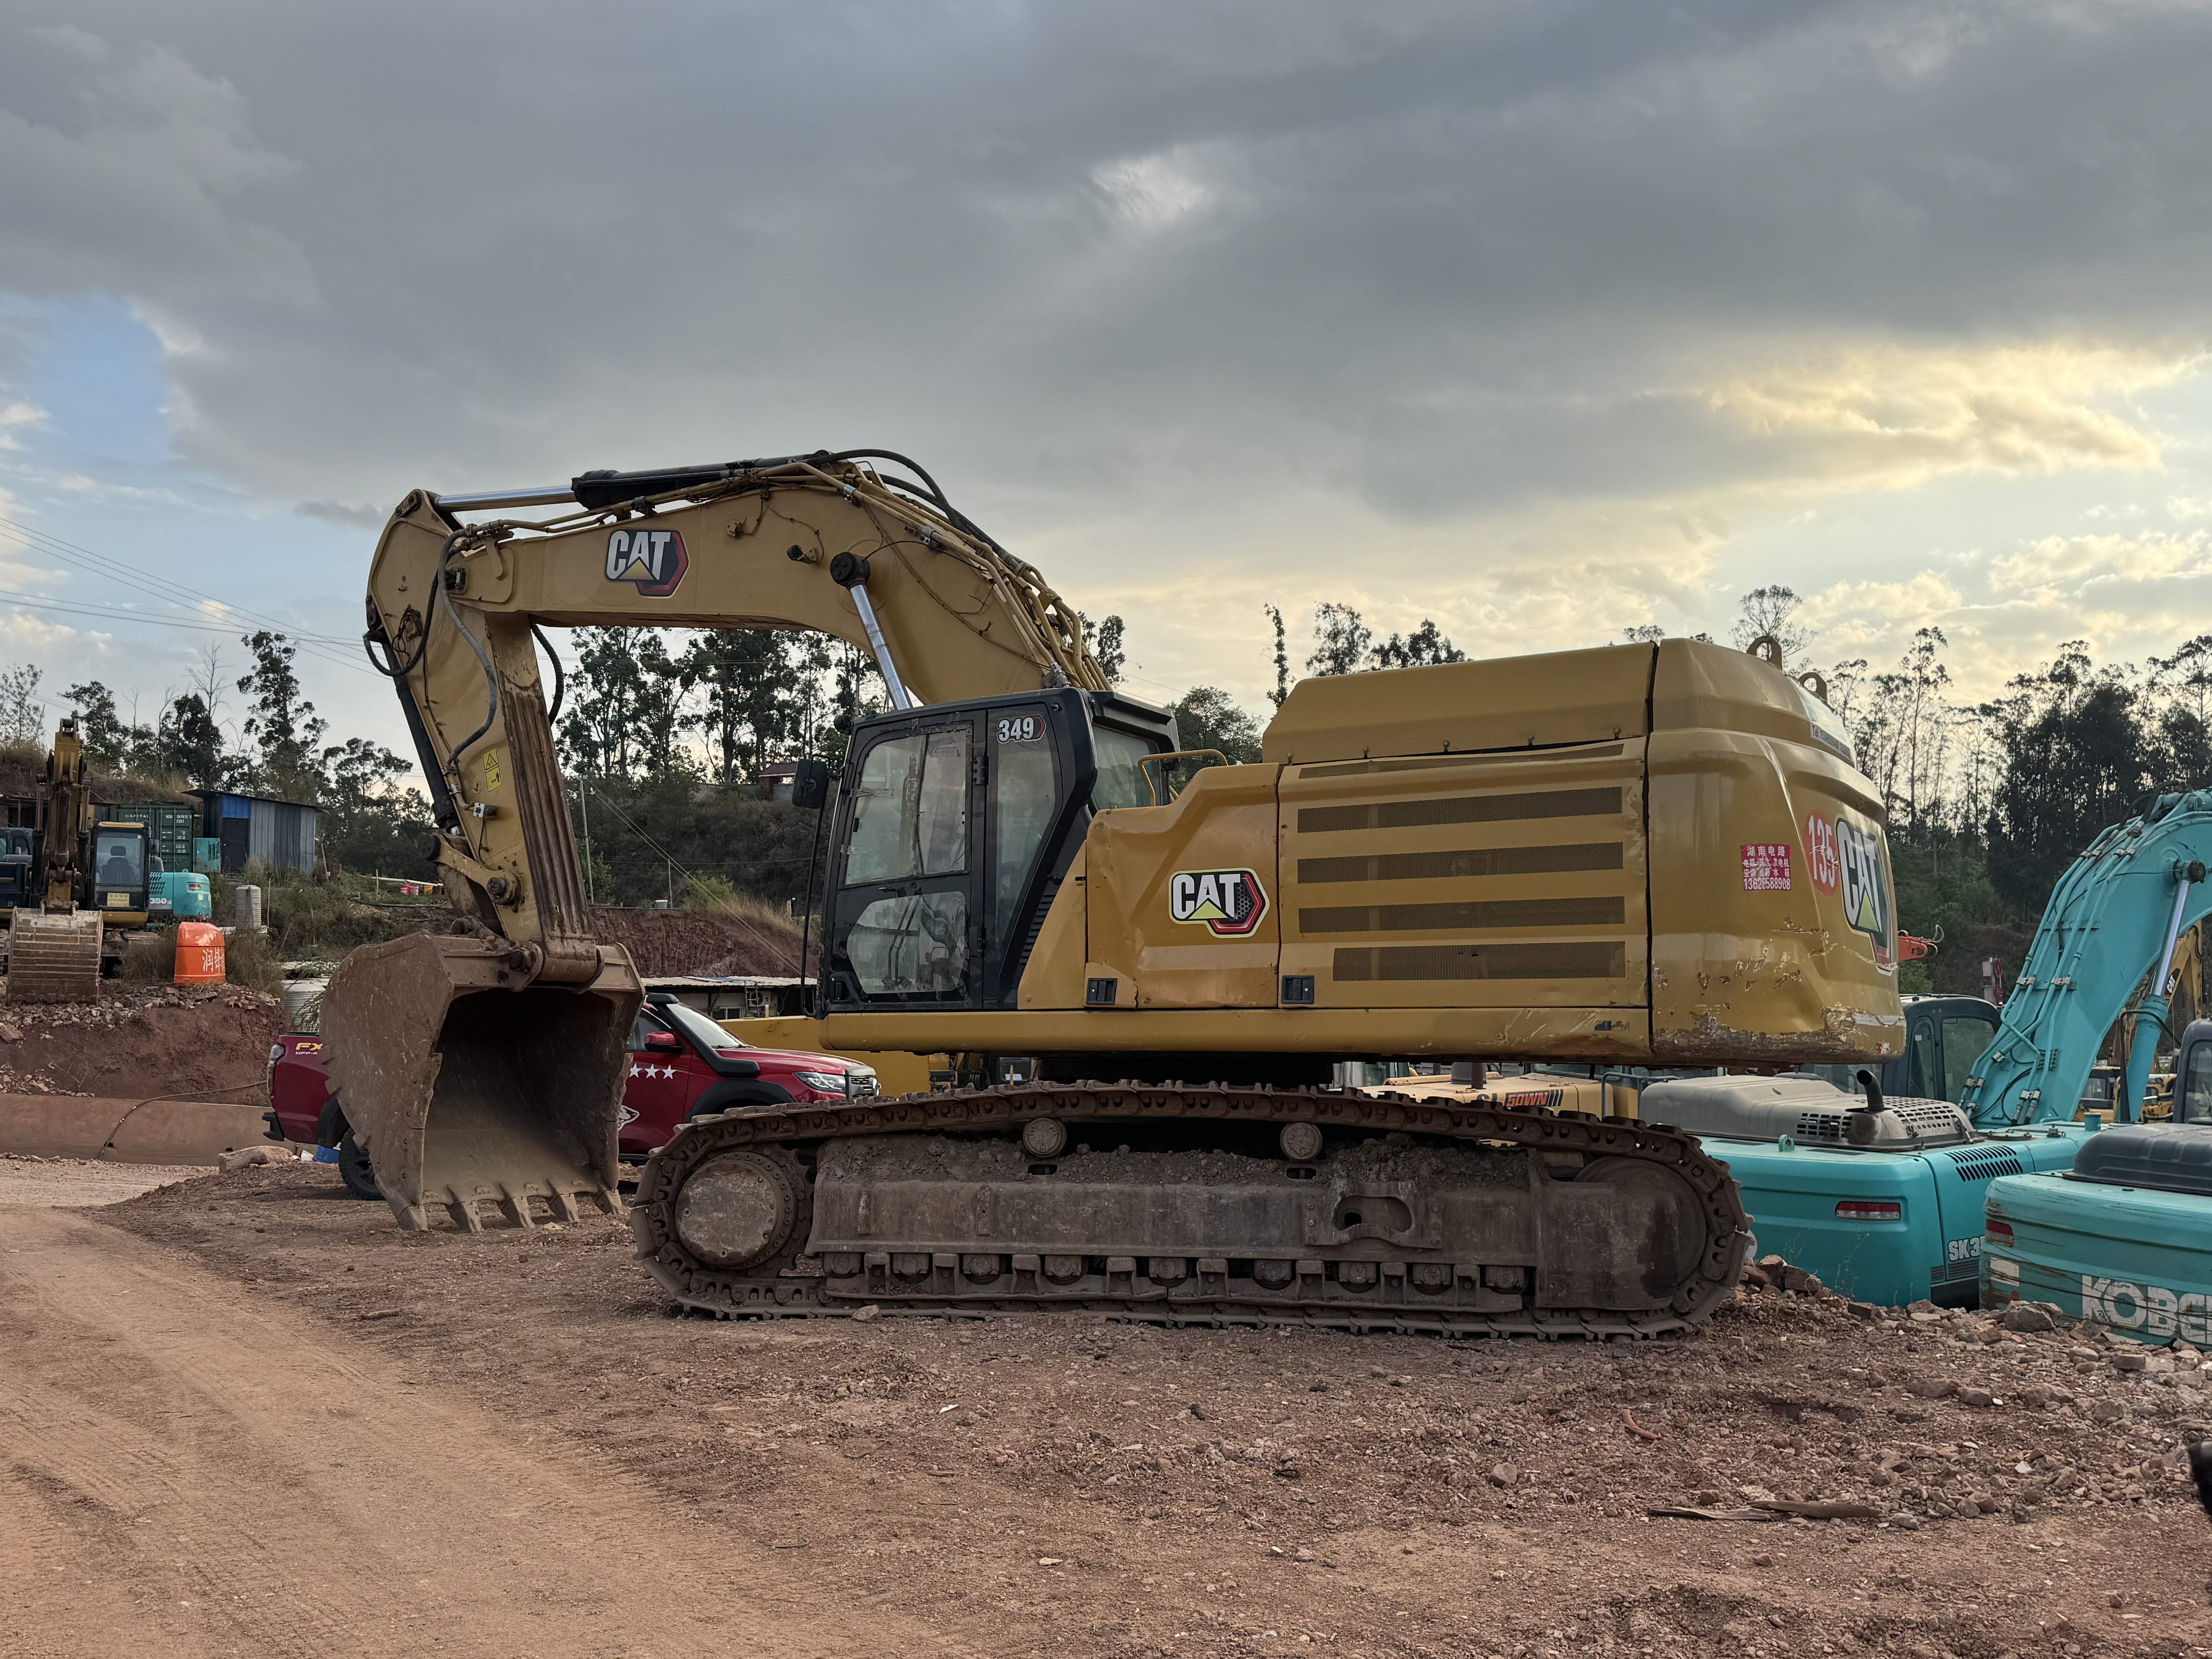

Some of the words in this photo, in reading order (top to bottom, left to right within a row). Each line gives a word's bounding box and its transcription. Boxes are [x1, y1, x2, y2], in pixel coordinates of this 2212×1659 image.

[607, 531, 671, 580] CAT
[999, 717, 1034, 741] 349
[1747, 845, 1785, 857] 湖南电路
[1808, 815, 1835, 888] 135
[1173, 874, 1240, 919] CAT
[1837, 821, 1882, 933] CAT
[2167, 974, 2176, 993] CAT
